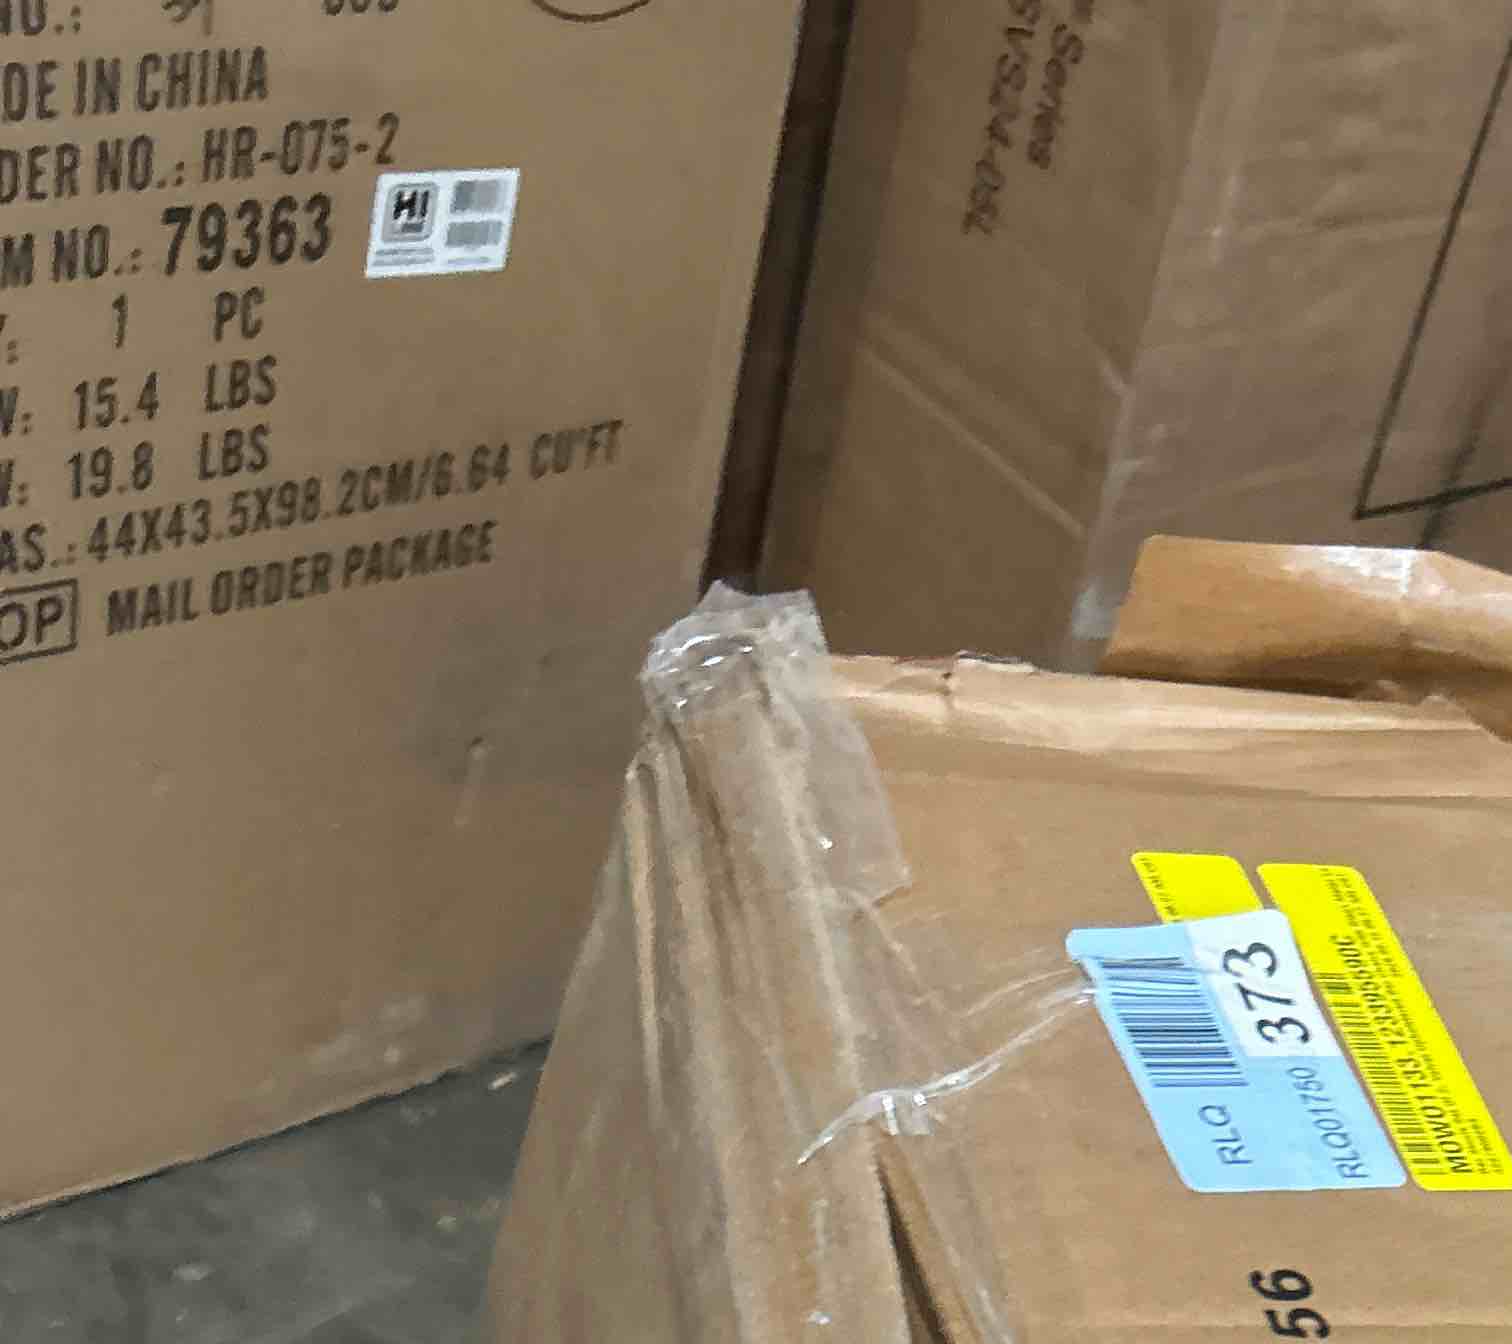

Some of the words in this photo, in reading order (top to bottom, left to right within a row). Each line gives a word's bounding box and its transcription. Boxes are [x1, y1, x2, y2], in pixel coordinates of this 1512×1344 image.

[74, 58, 121, 117] IN
[136, 46, 270, 113] CHINA
[0, 142, 80, 203] DER
[97, 134, 185, 195] NO.:
[202, 112, 401, 183] HR-075-2
[52, 225, 143, 284] NO.:
[161, 192, 333, 277] 79363
[111, 292, 129, 349] 1
[213, 285, 266, 343] PC
[73, 370, 161, 432] 15.4
[204, 354, 278, 413] LBS
[67, 440, 154, 500] 19.8
[198, 423, 270, 480] LBS
[106, 577, 199, 638] MAIL
[209, 551, 334, 617] ORDER
[342, 519, 499, 590] PACKAGE
[1222, 941, 1311, 1046] 373
[1199, 1103, 1254, 1166] RLQ
